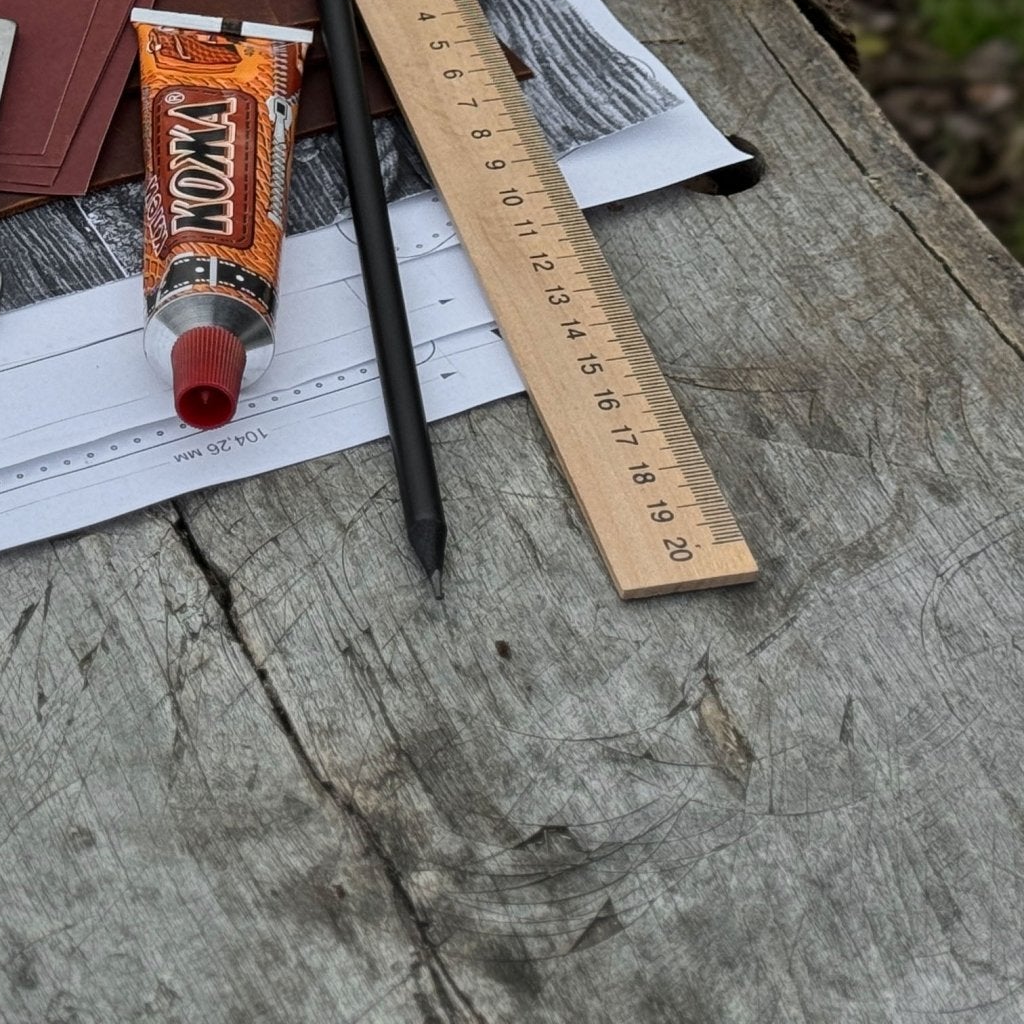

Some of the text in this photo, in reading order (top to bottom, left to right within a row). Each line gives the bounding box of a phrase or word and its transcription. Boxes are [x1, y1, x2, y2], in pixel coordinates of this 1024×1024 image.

[167, 96, 237, 235] КОЖА
[417, 11, 436, 23] 4
[430, 40, 450, 51] 5
[443, 69, 464, 80] 6
[457, 98, 478, 110] 7
[471, 128, 492, 140] 8
[485, 159, 506, 171] 9
[499, 187, 524, 207] 10
[514, 219, 538, 238] 11
[529, 252, 555, 272] 12
[544, 284, 571, 306] 13
[560, 318, 587, 340] 14
[577, 353, 604, 375] 15
[593, 388, 621, 411] 16
[611, 424, 639, 446] 17
[628, 461, 656, 485] 18
[646, 499, 675, 523] 19
[663, 537, 694, 562] 20
[206, 427, 268, 456] 104,26
